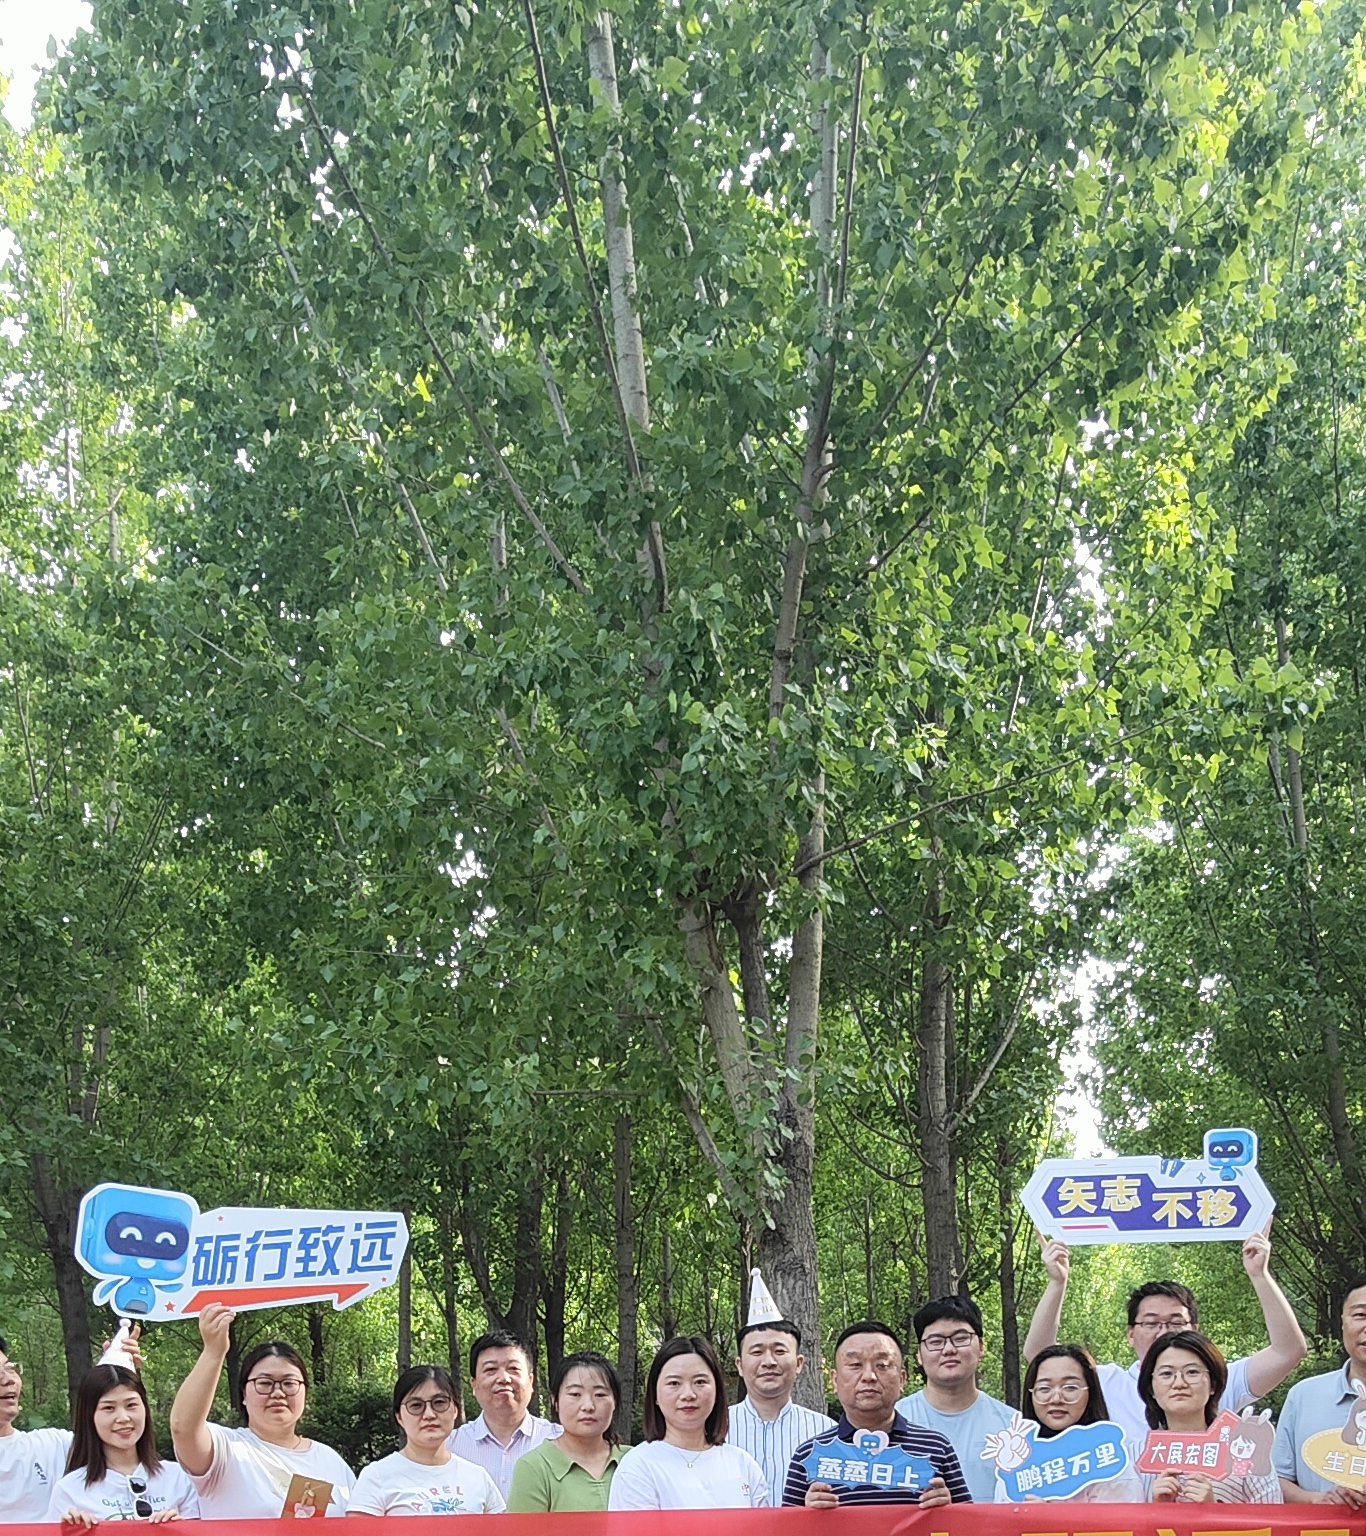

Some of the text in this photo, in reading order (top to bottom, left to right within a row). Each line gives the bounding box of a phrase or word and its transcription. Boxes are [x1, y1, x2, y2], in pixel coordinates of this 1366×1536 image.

[1057, 1176, 1238, 1228] 矢志不移
[192, 1221, 398, 1287] 砺行致远
[817, 1457, 920, 1488] 蒸蒸日上
[1015, 1442, 1120, 1493] 鹏程万里
[1149, 1441, 1220, 1468] 大展宏图
[101, 1498, 122, 1508] Out
